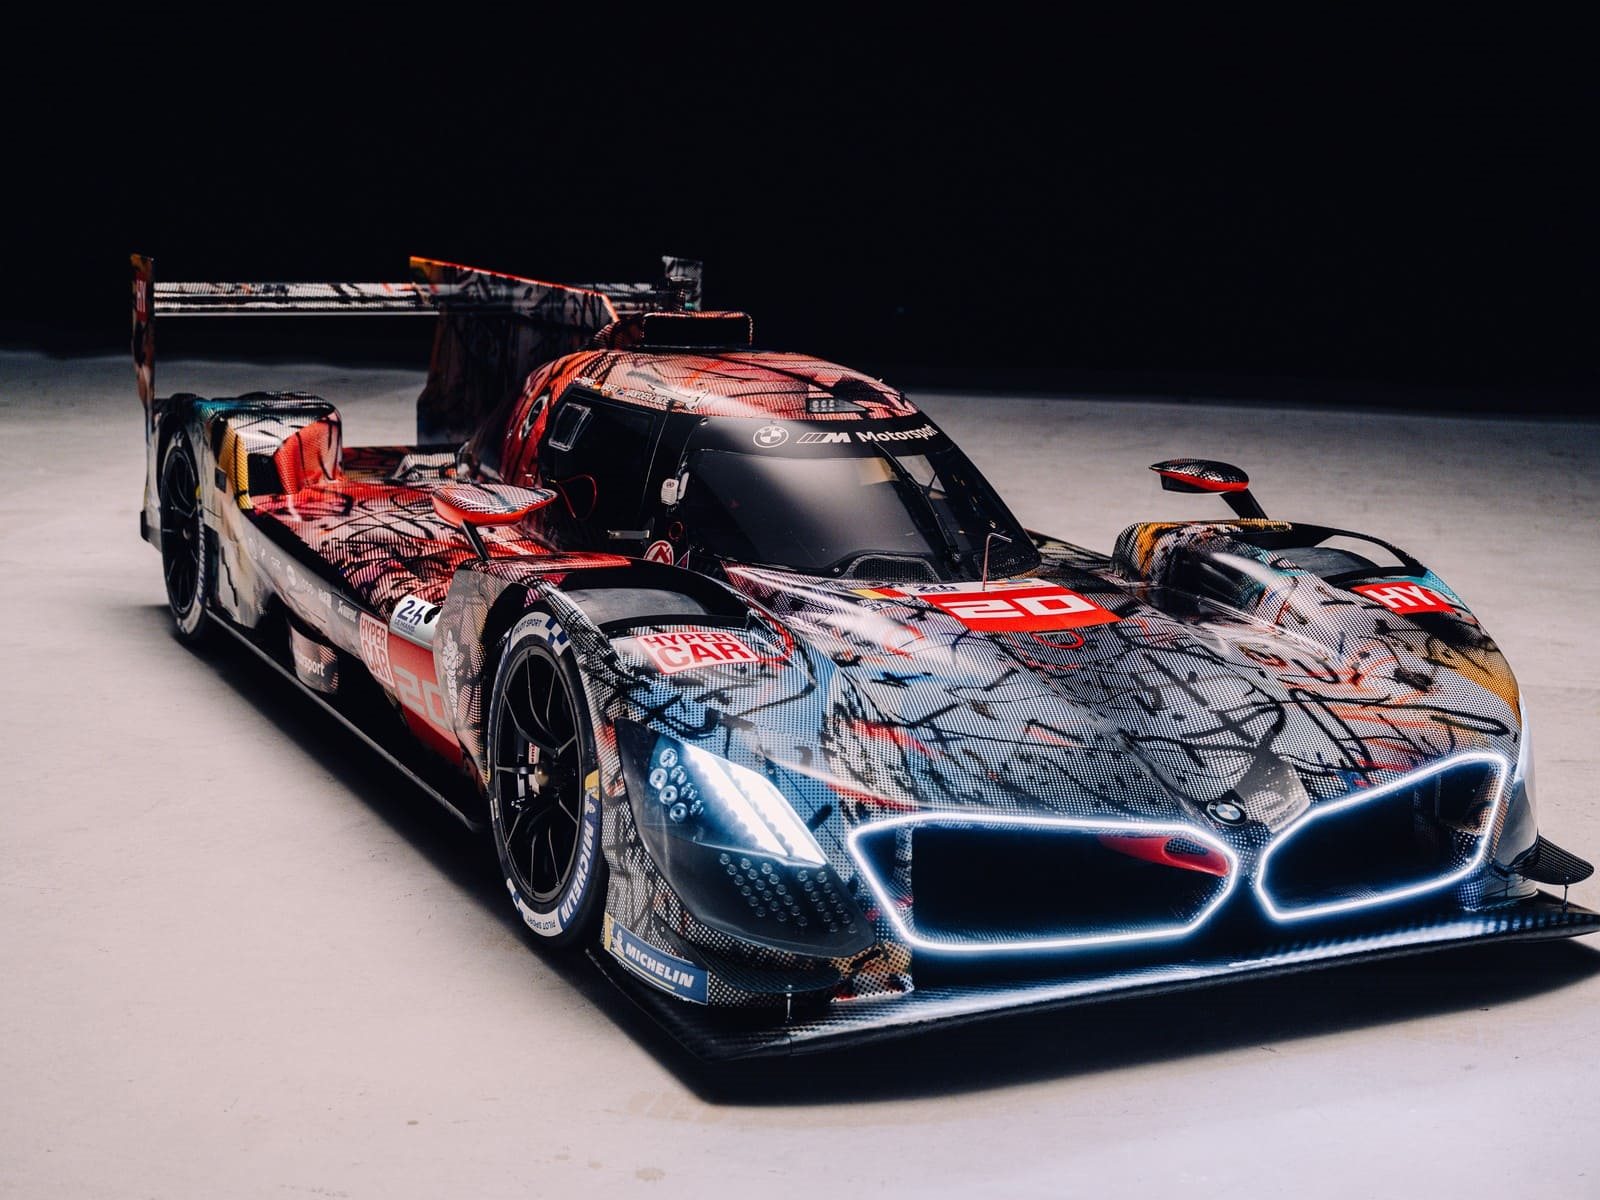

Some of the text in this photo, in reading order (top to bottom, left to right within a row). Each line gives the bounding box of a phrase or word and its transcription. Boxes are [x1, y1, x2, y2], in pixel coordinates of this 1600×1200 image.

[855, 424, 939, 443] Motorsport
[940, 594, 1097, 619] 20
[361, 618, 386, 650] HYPER
[643, 633, 734, 647] HYPER
[363, 640, 391, 684] CAR
[656, 642, 750, 667] CAR
[394, 665, 454, 731] 20
[560, 820, 594, 922] MICHELIN
[625, 942, 694, 988] MICHELIN
